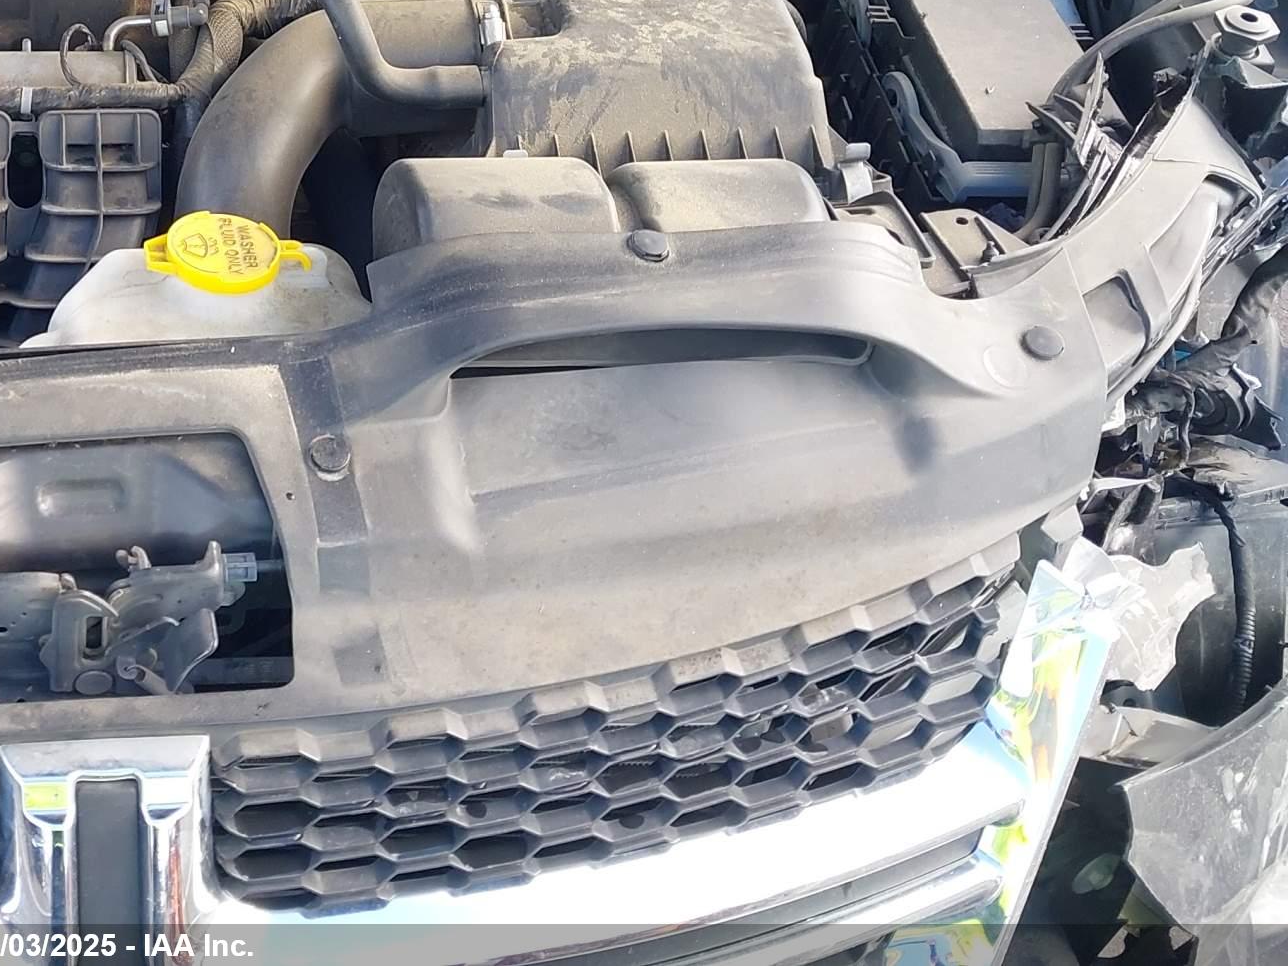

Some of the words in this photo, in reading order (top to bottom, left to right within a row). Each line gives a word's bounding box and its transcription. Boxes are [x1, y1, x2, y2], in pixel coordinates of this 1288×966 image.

[217, 216, 236, 248] FLUID
[236, 223, 259, 269] WASHER
[223, 248, 244, 276] ONLY
